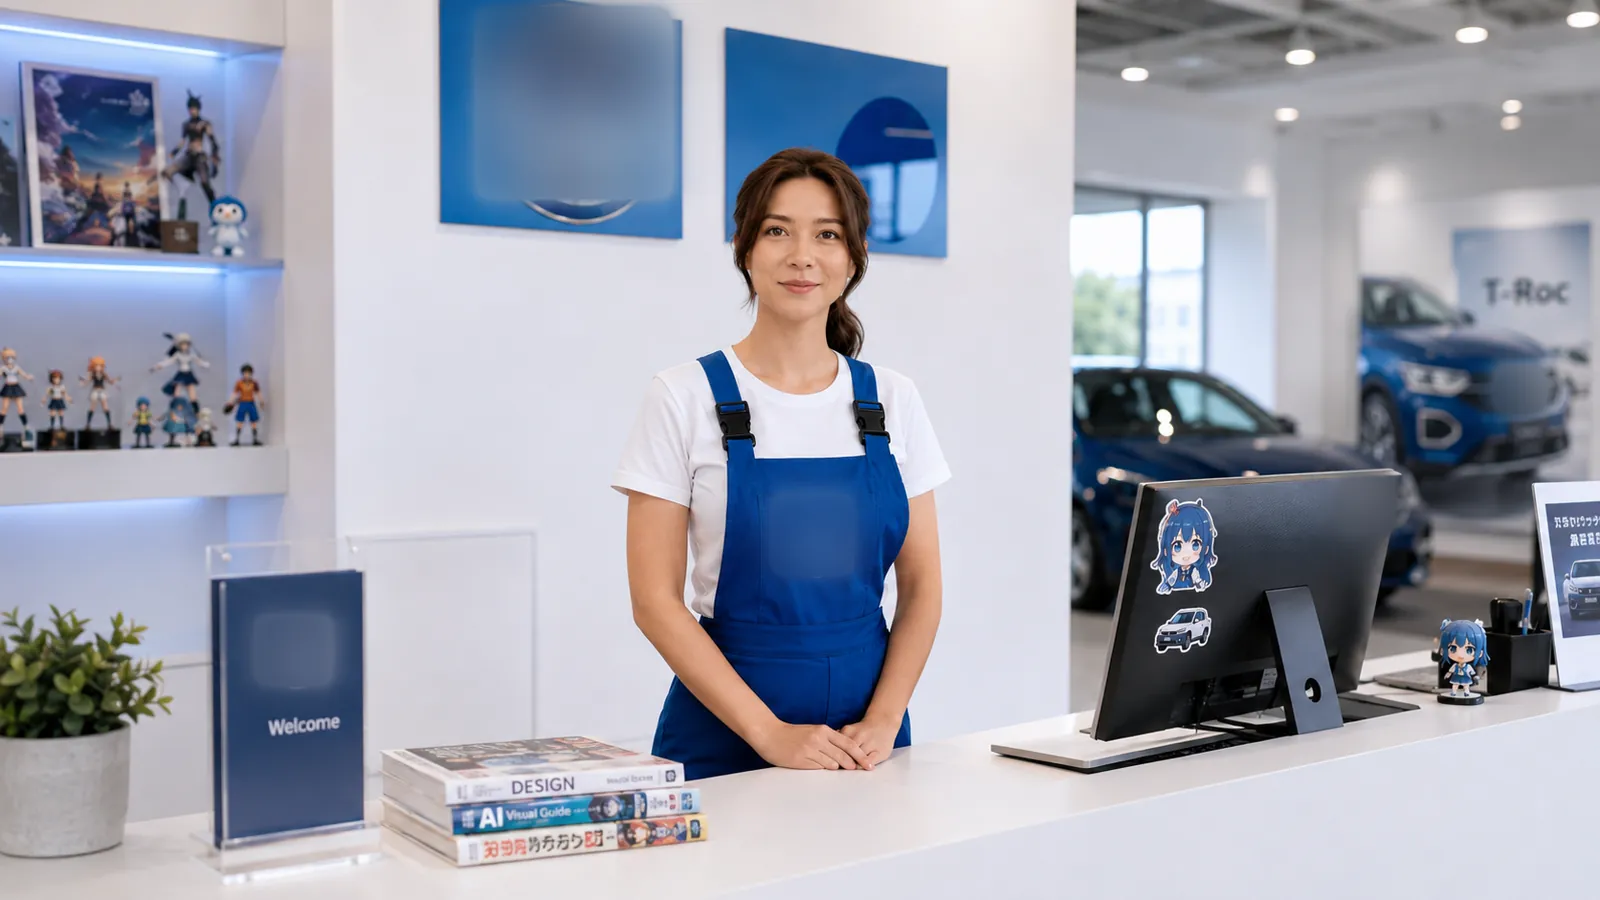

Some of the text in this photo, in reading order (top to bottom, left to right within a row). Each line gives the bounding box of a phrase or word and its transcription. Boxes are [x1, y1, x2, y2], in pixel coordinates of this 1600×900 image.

[1483, 277, 1570, 307] T-Roc
[268, 715, 341, 737] Welcome
[511, 776, 575, 795] DESIGN
[478, 806, 504, 829] AI
[505, 809, 538, 822] Visual
[539, 806, 572, 818] Guide
